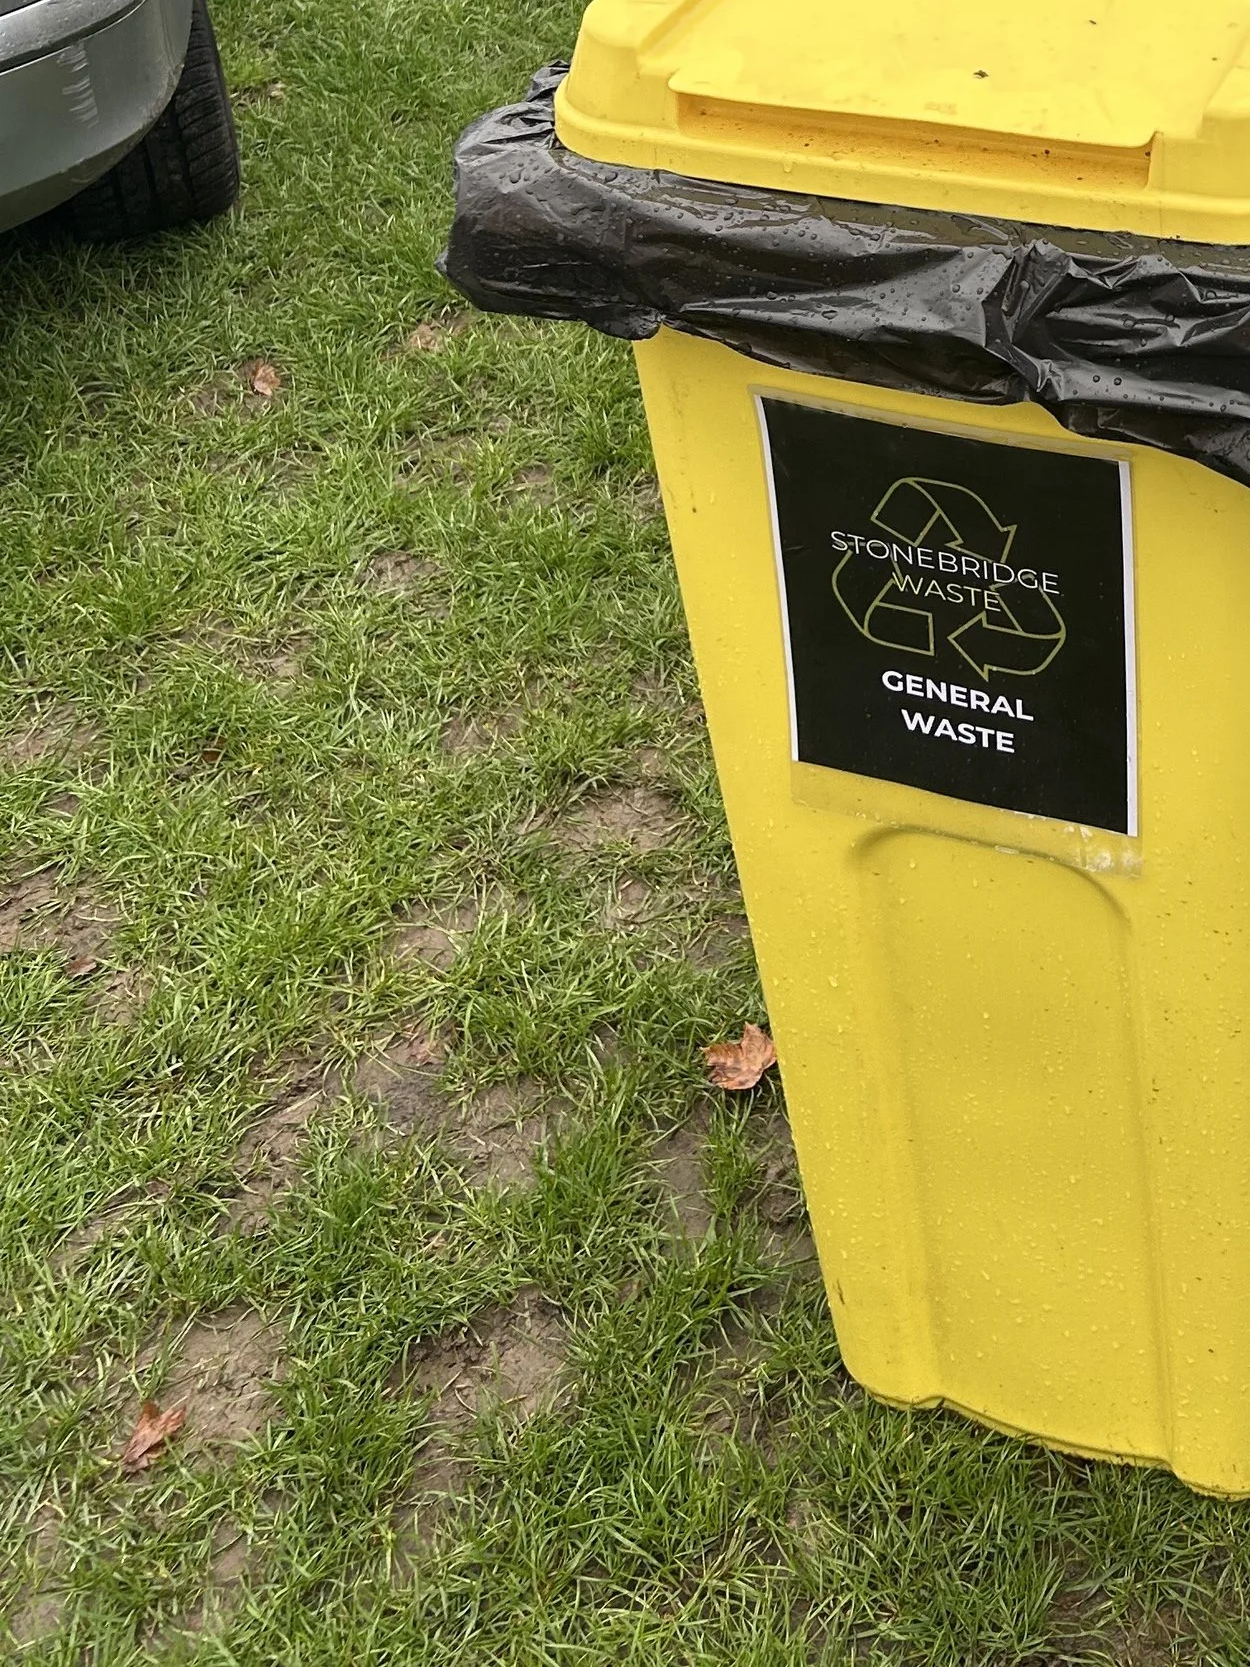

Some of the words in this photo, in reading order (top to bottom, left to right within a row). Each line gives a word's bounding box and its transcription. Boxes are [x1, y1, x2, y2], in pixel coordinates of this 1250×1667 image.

[830, 530, 1061, 594] STONEBRIDGE
[892, 571, 1001, 612] WASTE
[881, 670, 1034, 722] GENERAL
[901, 708, 1015, 753] WASTE
